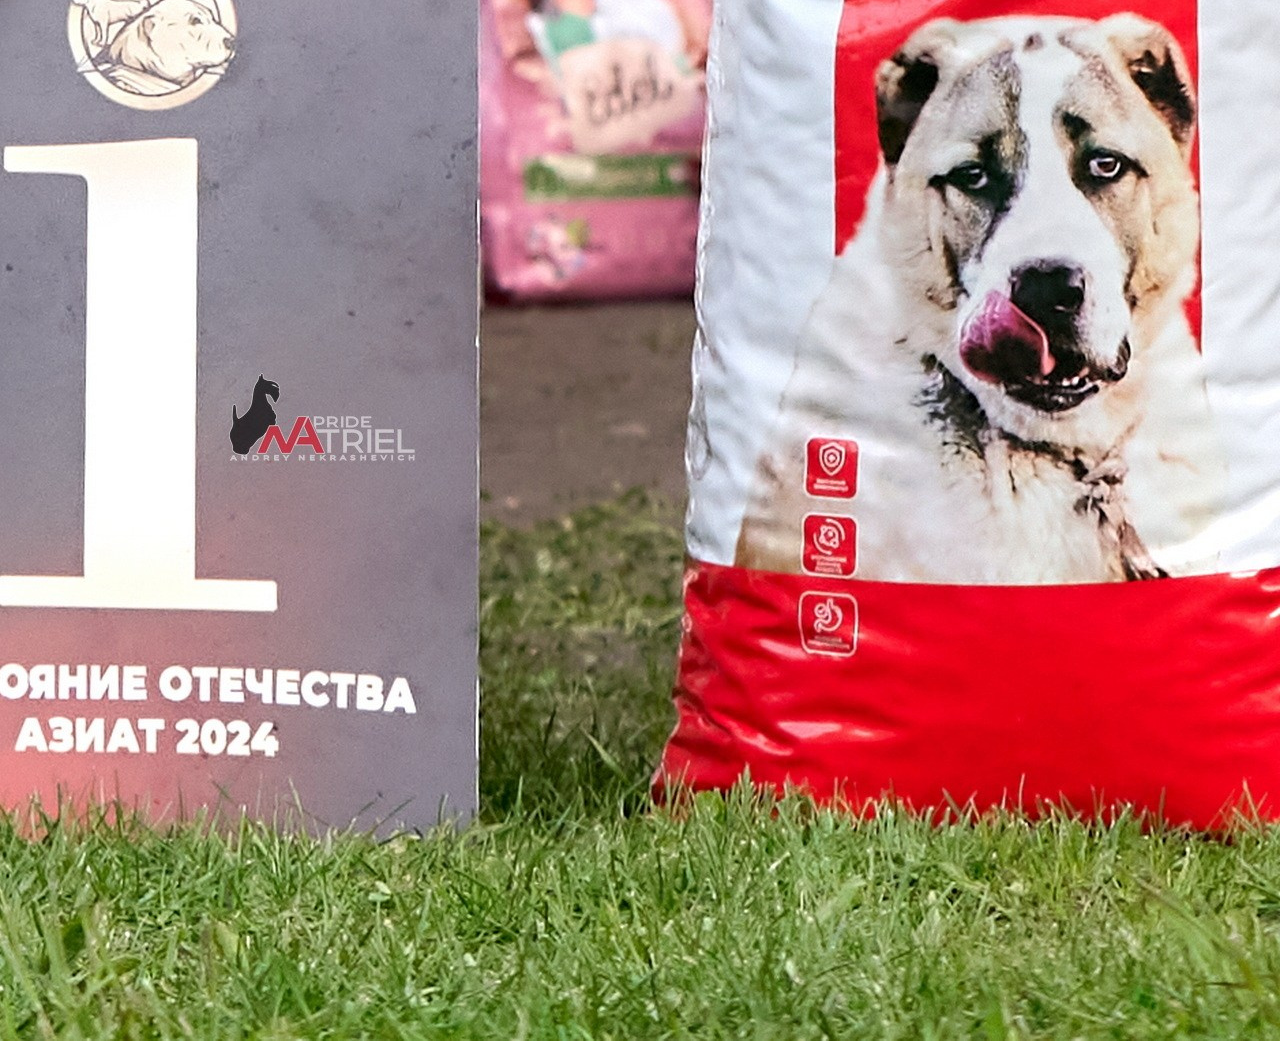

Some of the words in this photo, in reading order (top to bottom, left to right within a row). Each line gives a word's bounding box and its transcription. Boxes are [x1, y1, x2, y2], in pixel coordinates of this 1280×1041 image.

[159, 665, 417, 714] ОТЕЧЕСТВА
[15, 716, 165, 753] АЗИАТ
[175, 719, 279, 757] 2024
